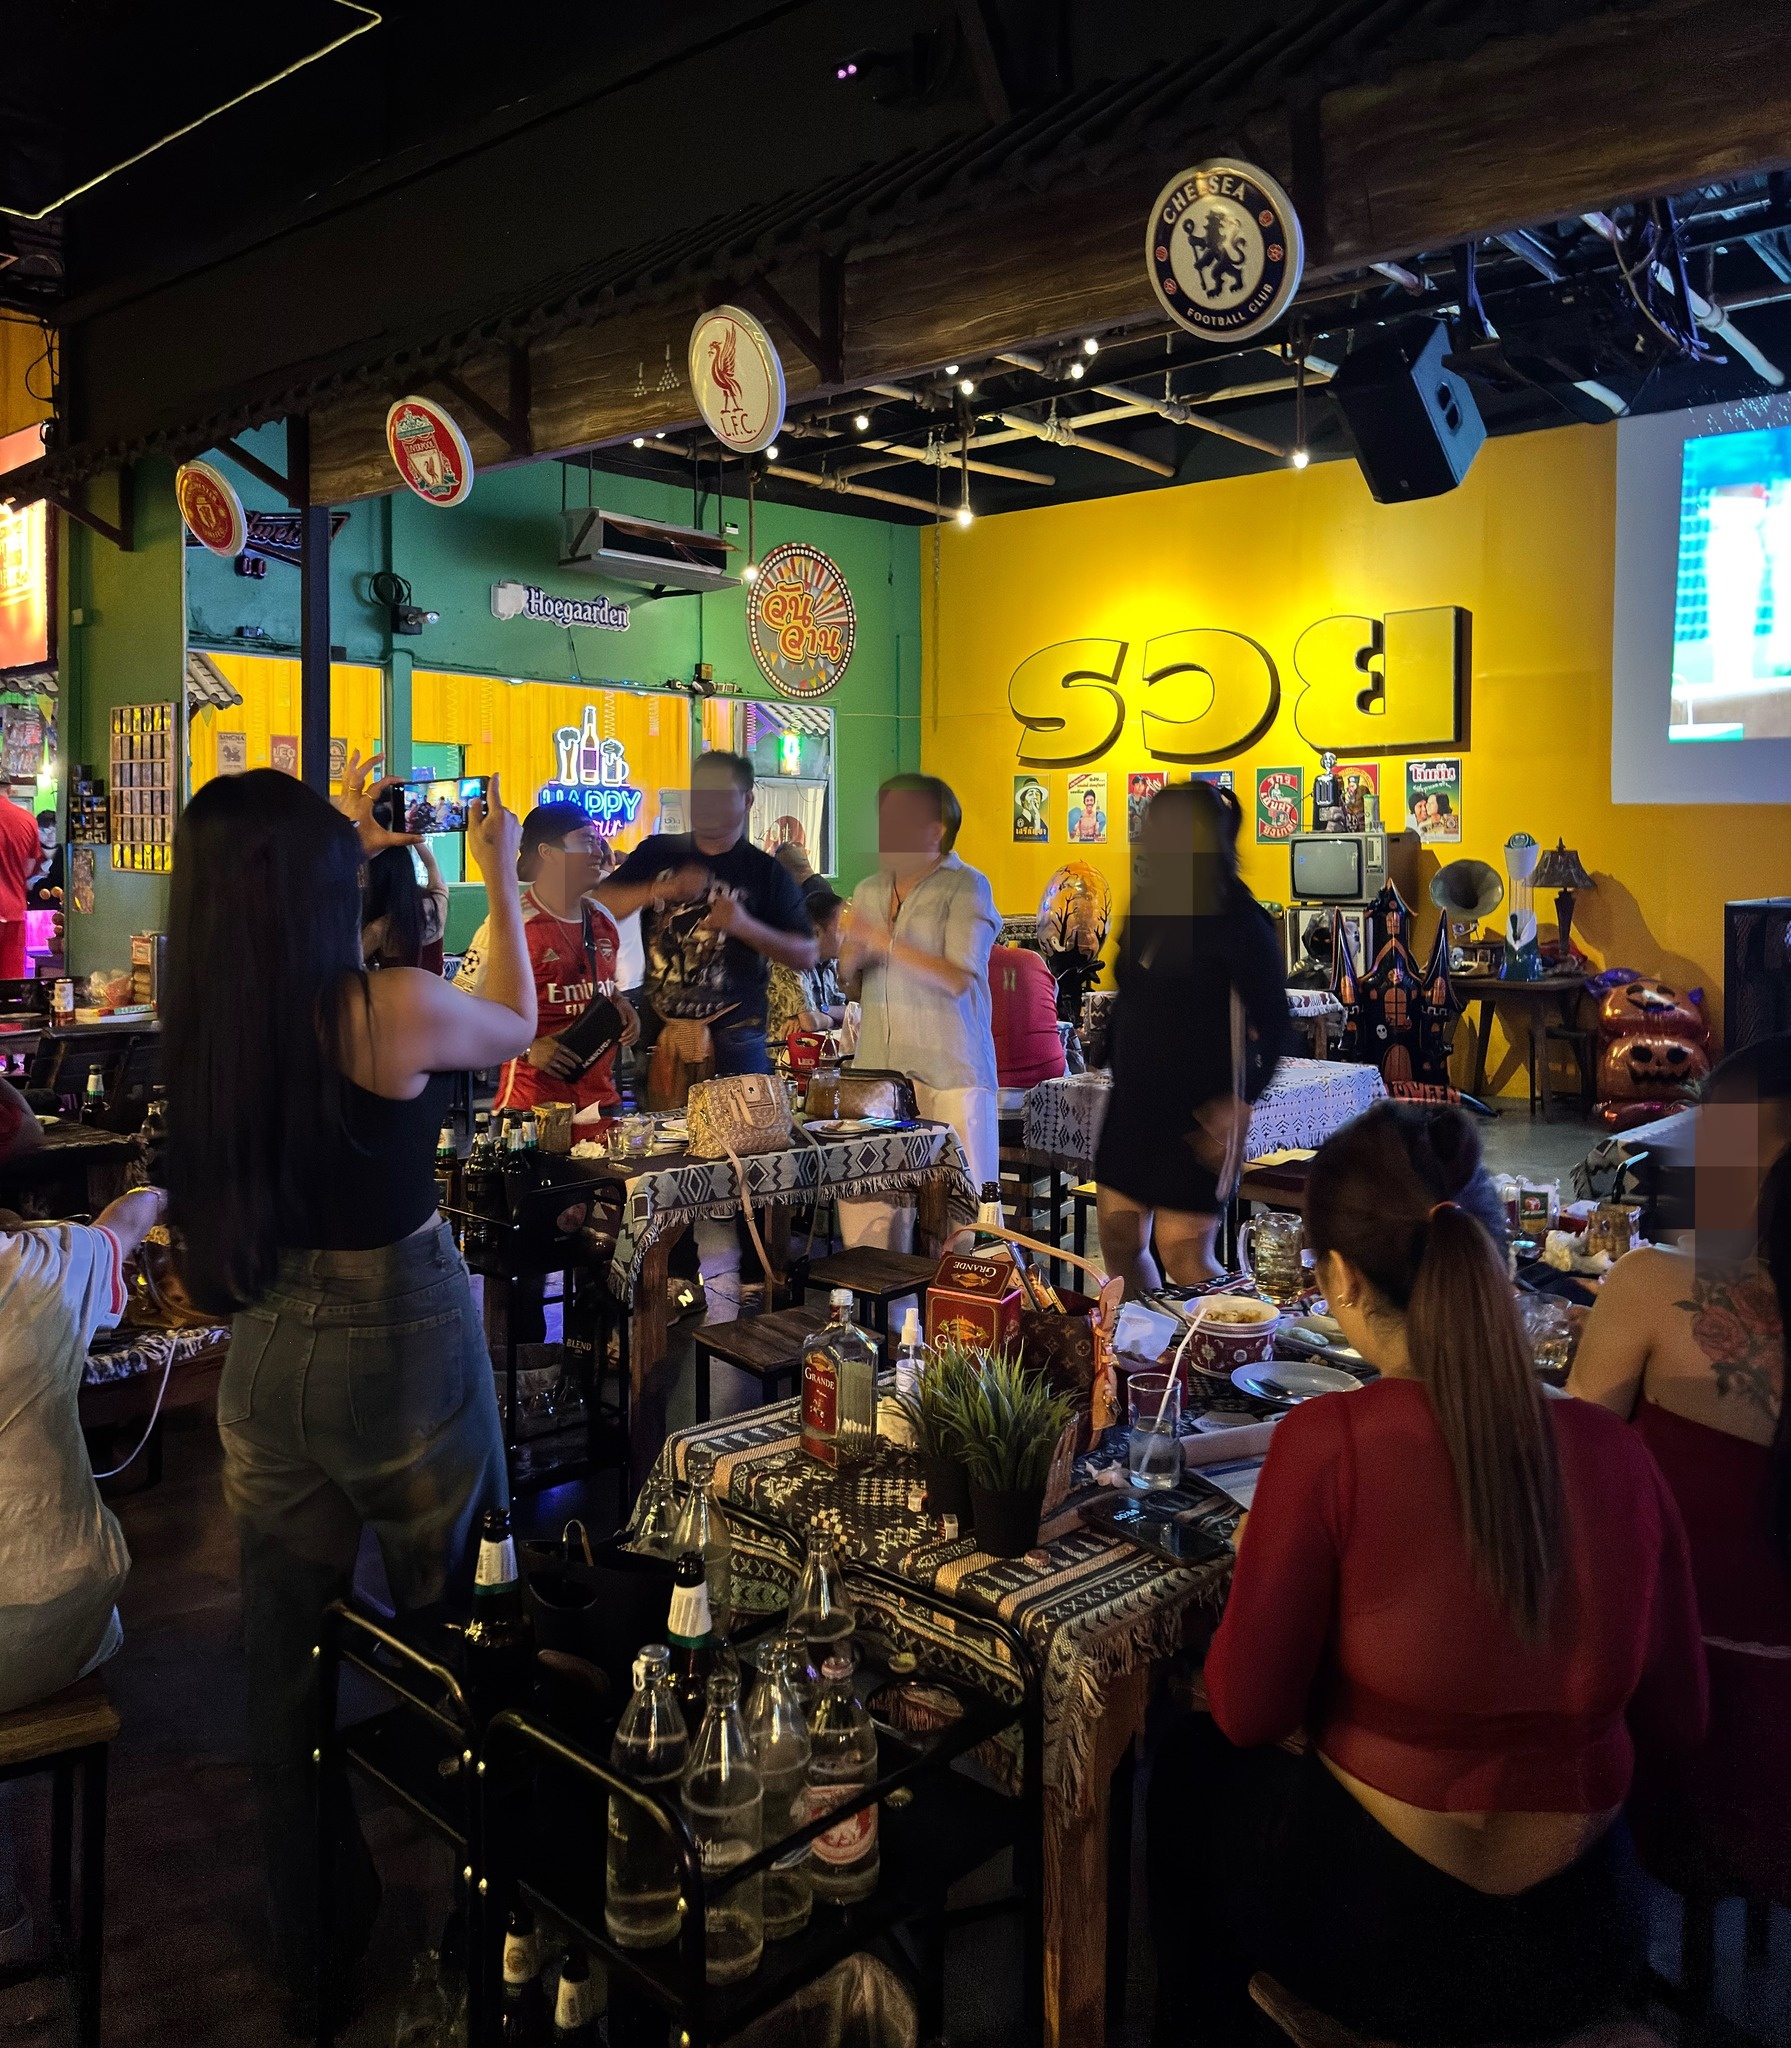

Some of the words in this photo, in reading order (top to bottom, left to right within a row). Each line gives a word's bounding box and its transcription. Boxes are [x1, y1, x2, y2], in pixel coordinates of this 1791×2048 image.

[1187, 308, 1246, 327] FOOTBALL
[1248, 283, 1273, 314] CLUB
[406, 441, 435, 453] LIVERPOOL
[529, 588, 628, 625] Hoegaarden
[1008, 605, 1472, 762] รวย
[273, 747, 296, 757] LEO
[797, 1057, 816, 1066] LEO
[953, 1261, 997, 1279] GRANDE
[565, 1338, 592, 1352] BLEND
[804, 1366, 835, 1390] GRANDE
